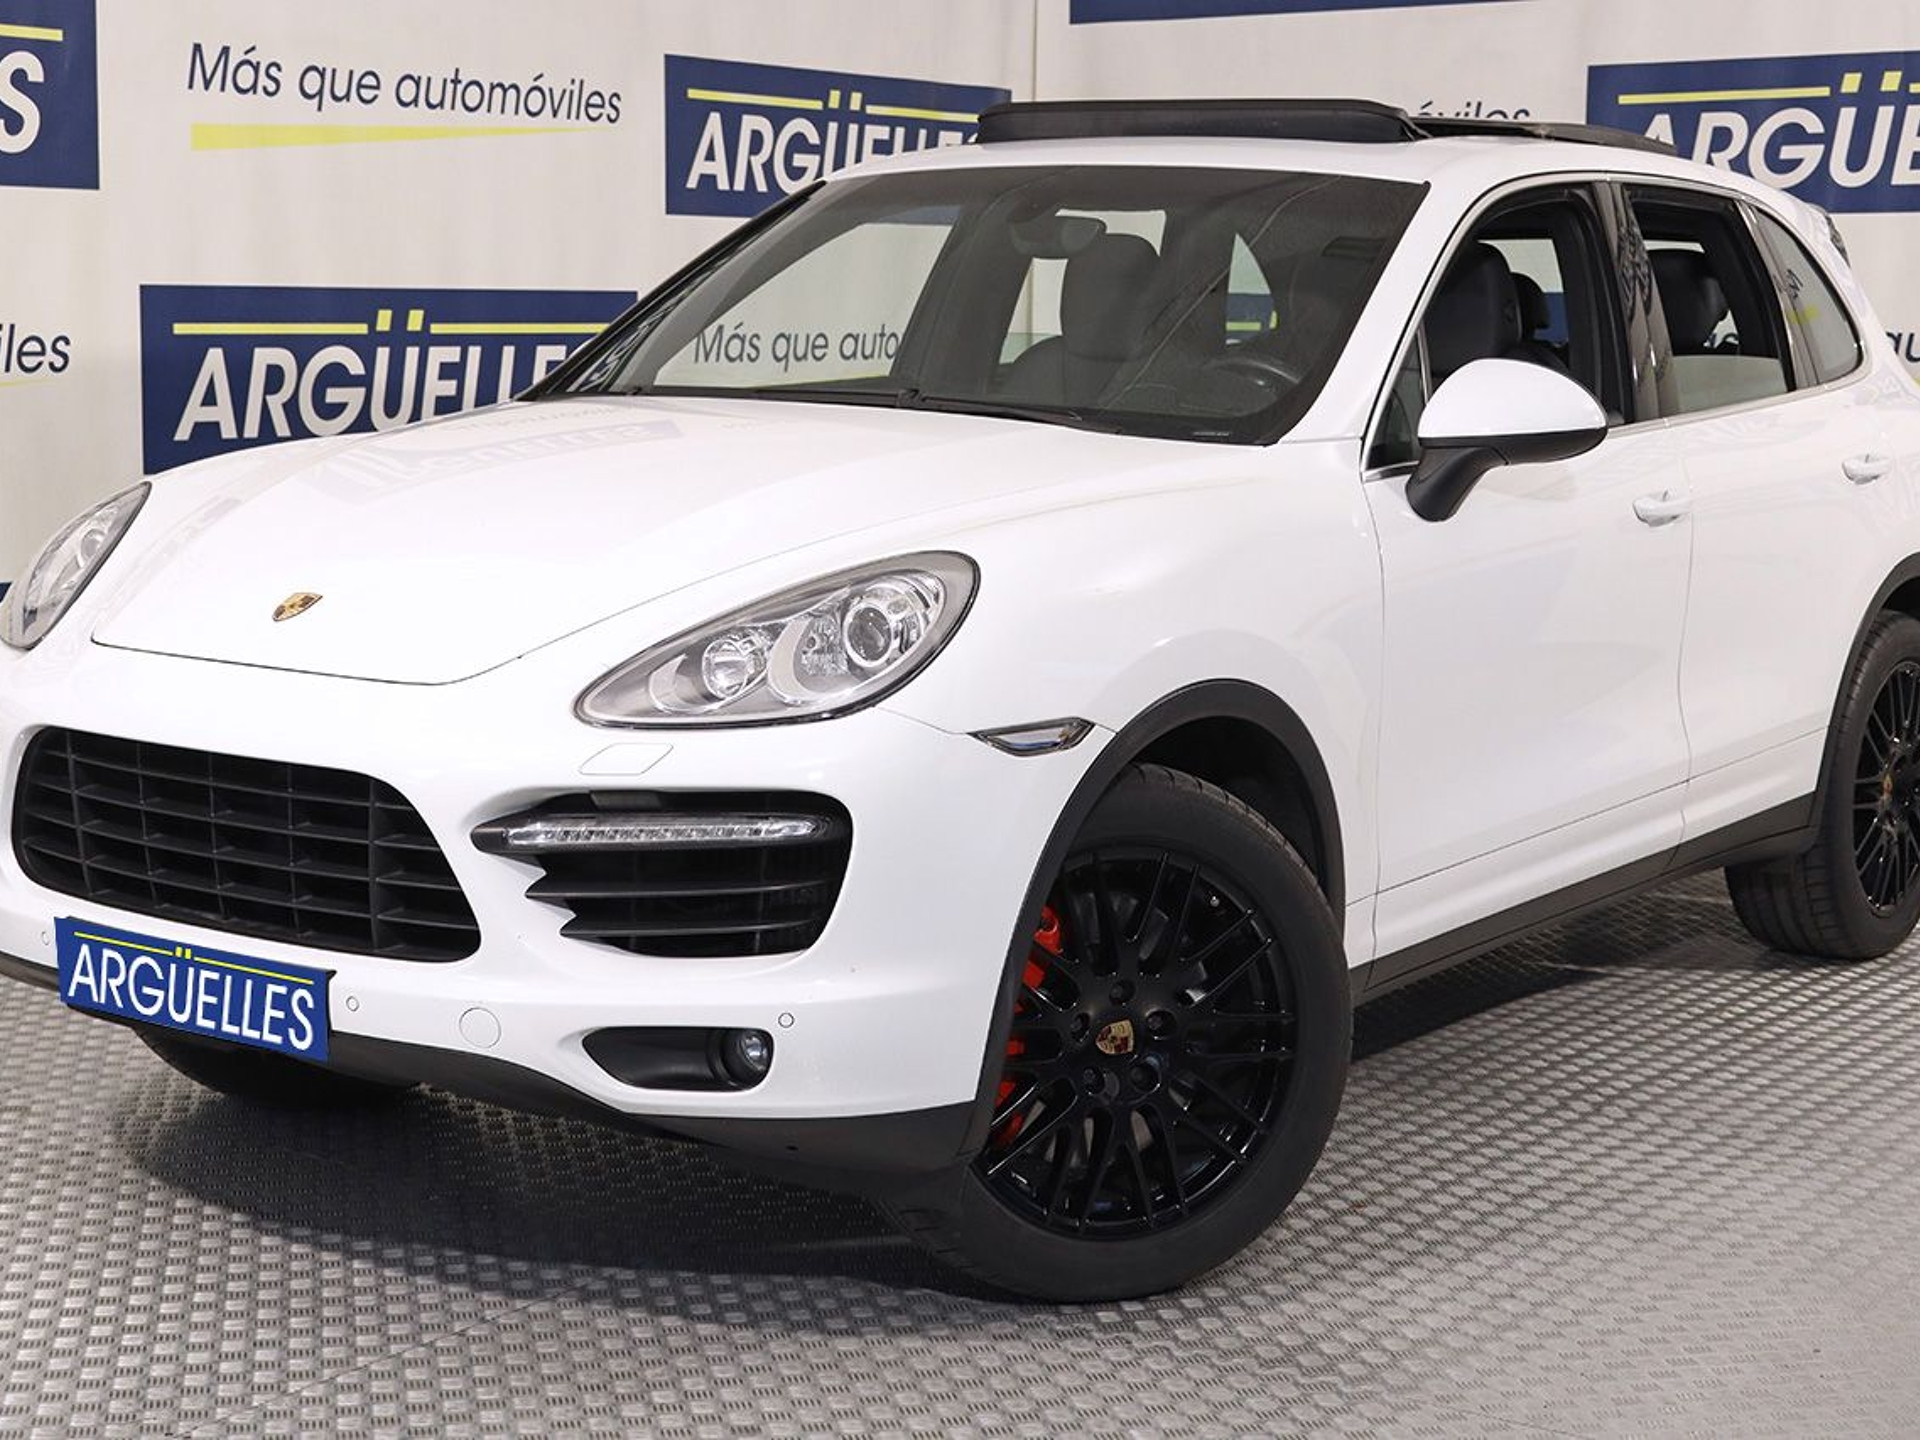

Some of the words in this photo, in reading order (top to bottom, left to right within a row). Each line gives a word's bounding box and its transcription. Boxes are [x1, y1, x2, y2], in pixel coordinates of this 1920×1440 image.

[187, 42, 283, 97] Más
[299, 63, 381, 112] que
[395, 67, 622, 124] automóviles
[694, 322, 761, 364] Más
[771, 331, 829, 373] que
[68, 943, 314, 1050] ARGÜELLES
